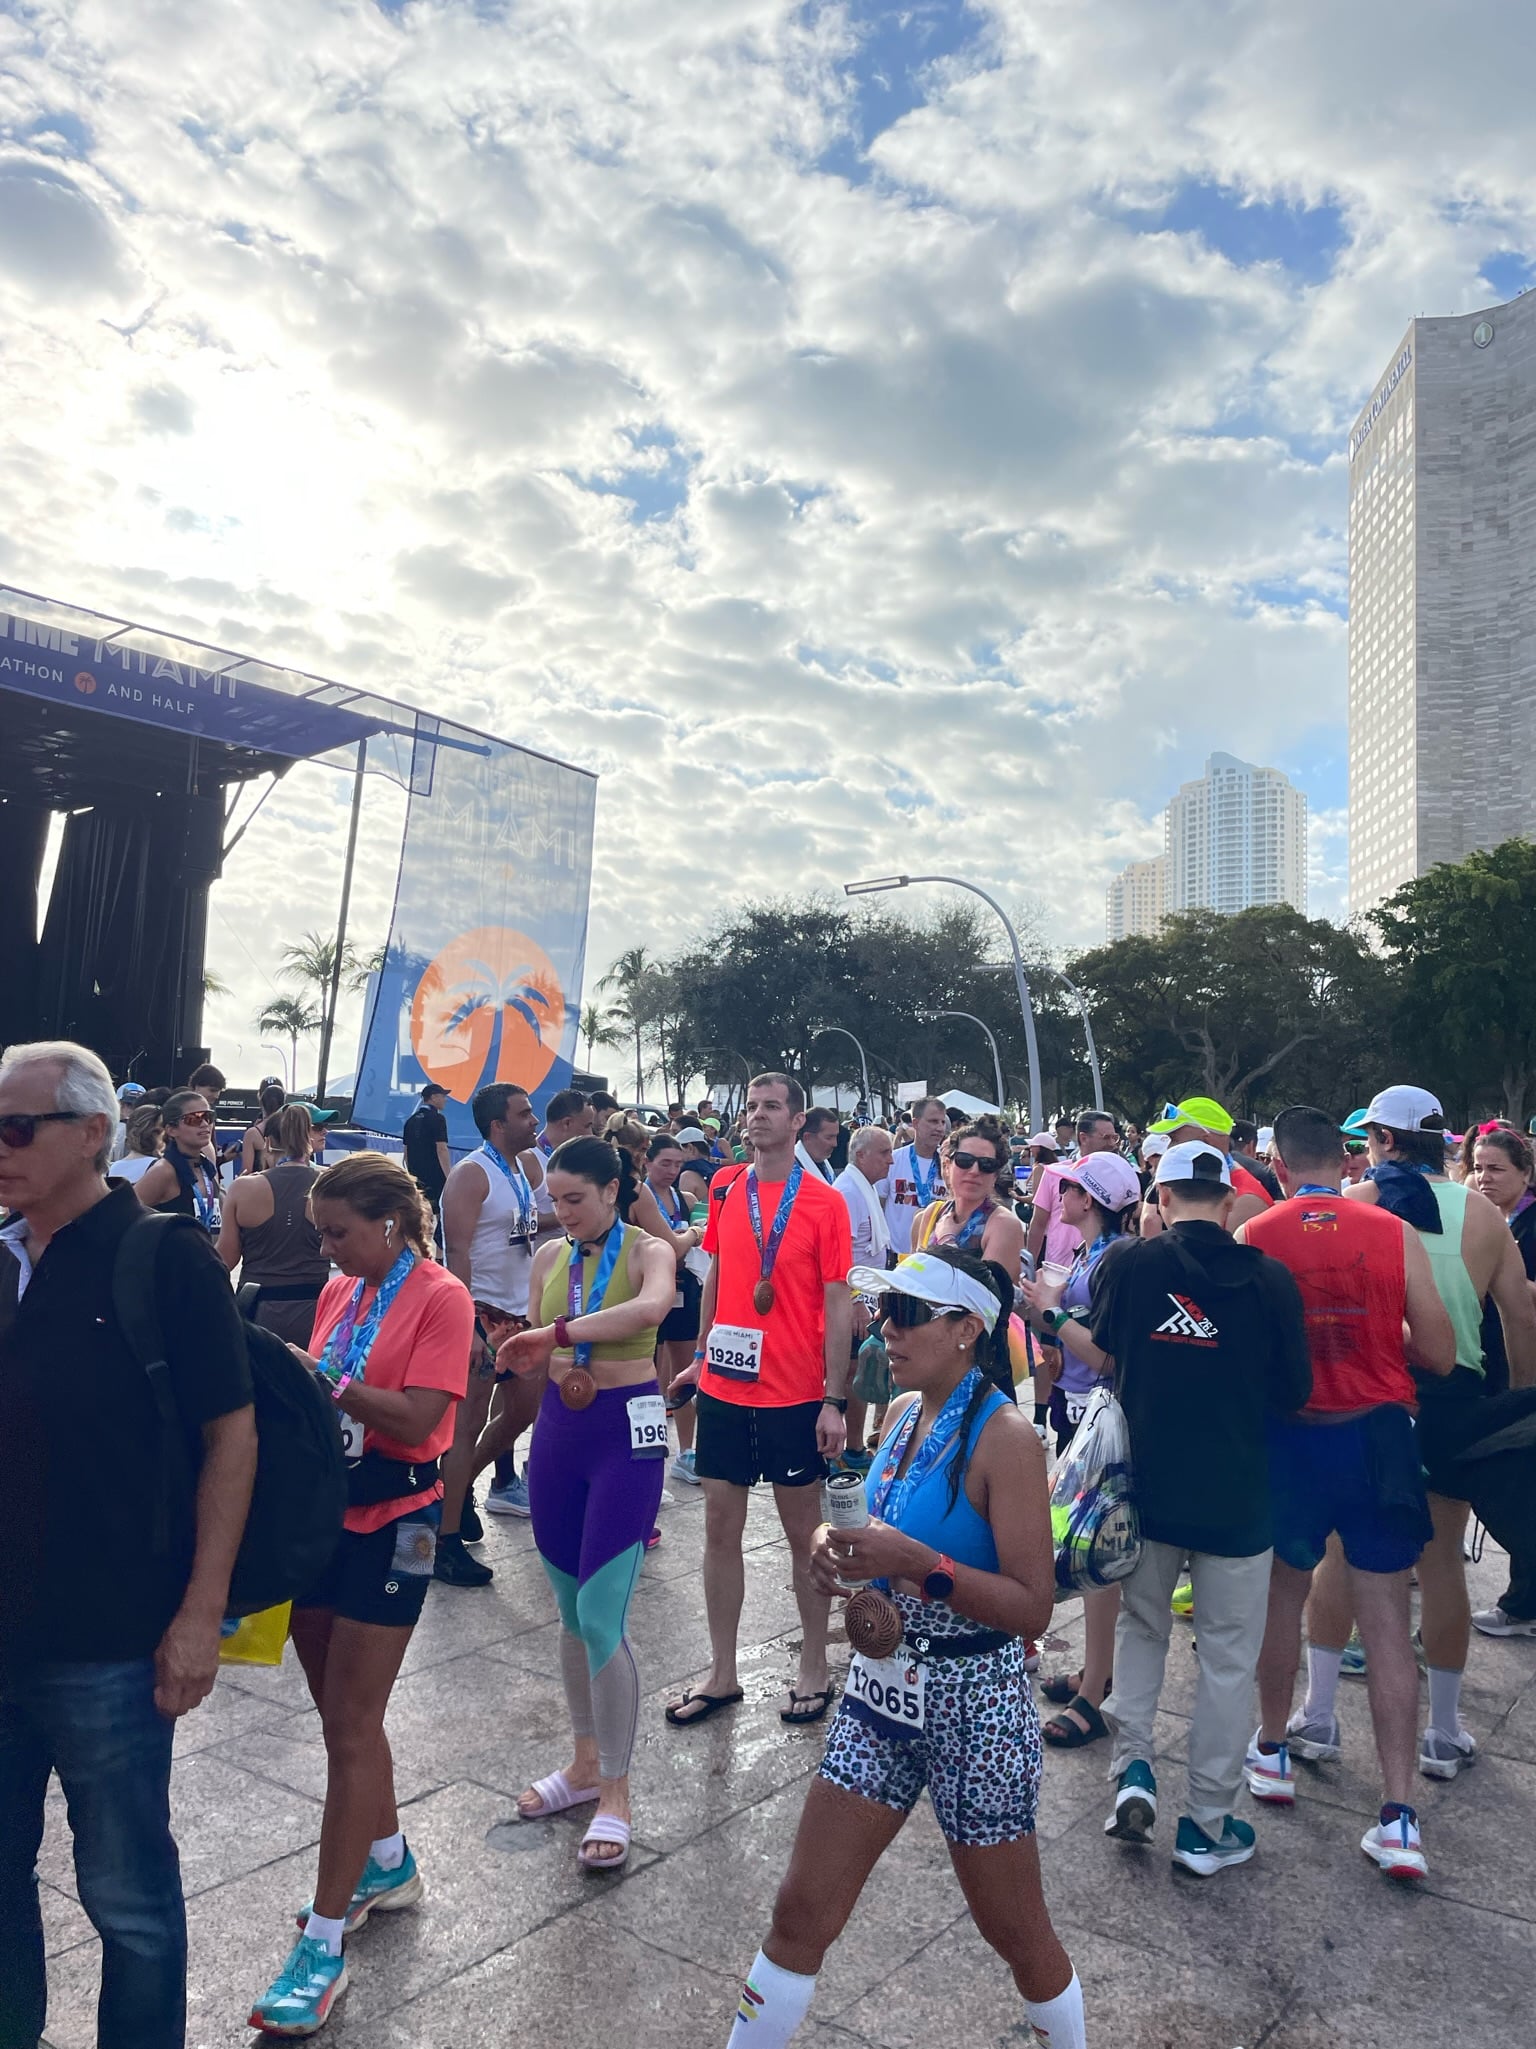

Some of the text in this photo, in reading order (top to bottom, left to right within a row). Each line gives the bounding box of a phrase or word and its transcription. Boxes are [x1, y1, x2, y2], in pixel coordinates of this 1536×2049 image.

[107, 683, 143, 702] AND
[152, 694, 195, 714] HALF
[437, 792, 575, 871] MIAMI
[1303, 1223, 1338, 1232] 13.1
[1198, 1317, 1219, 1338] 26.2
[709, 1346, 756, 1369] 19284
